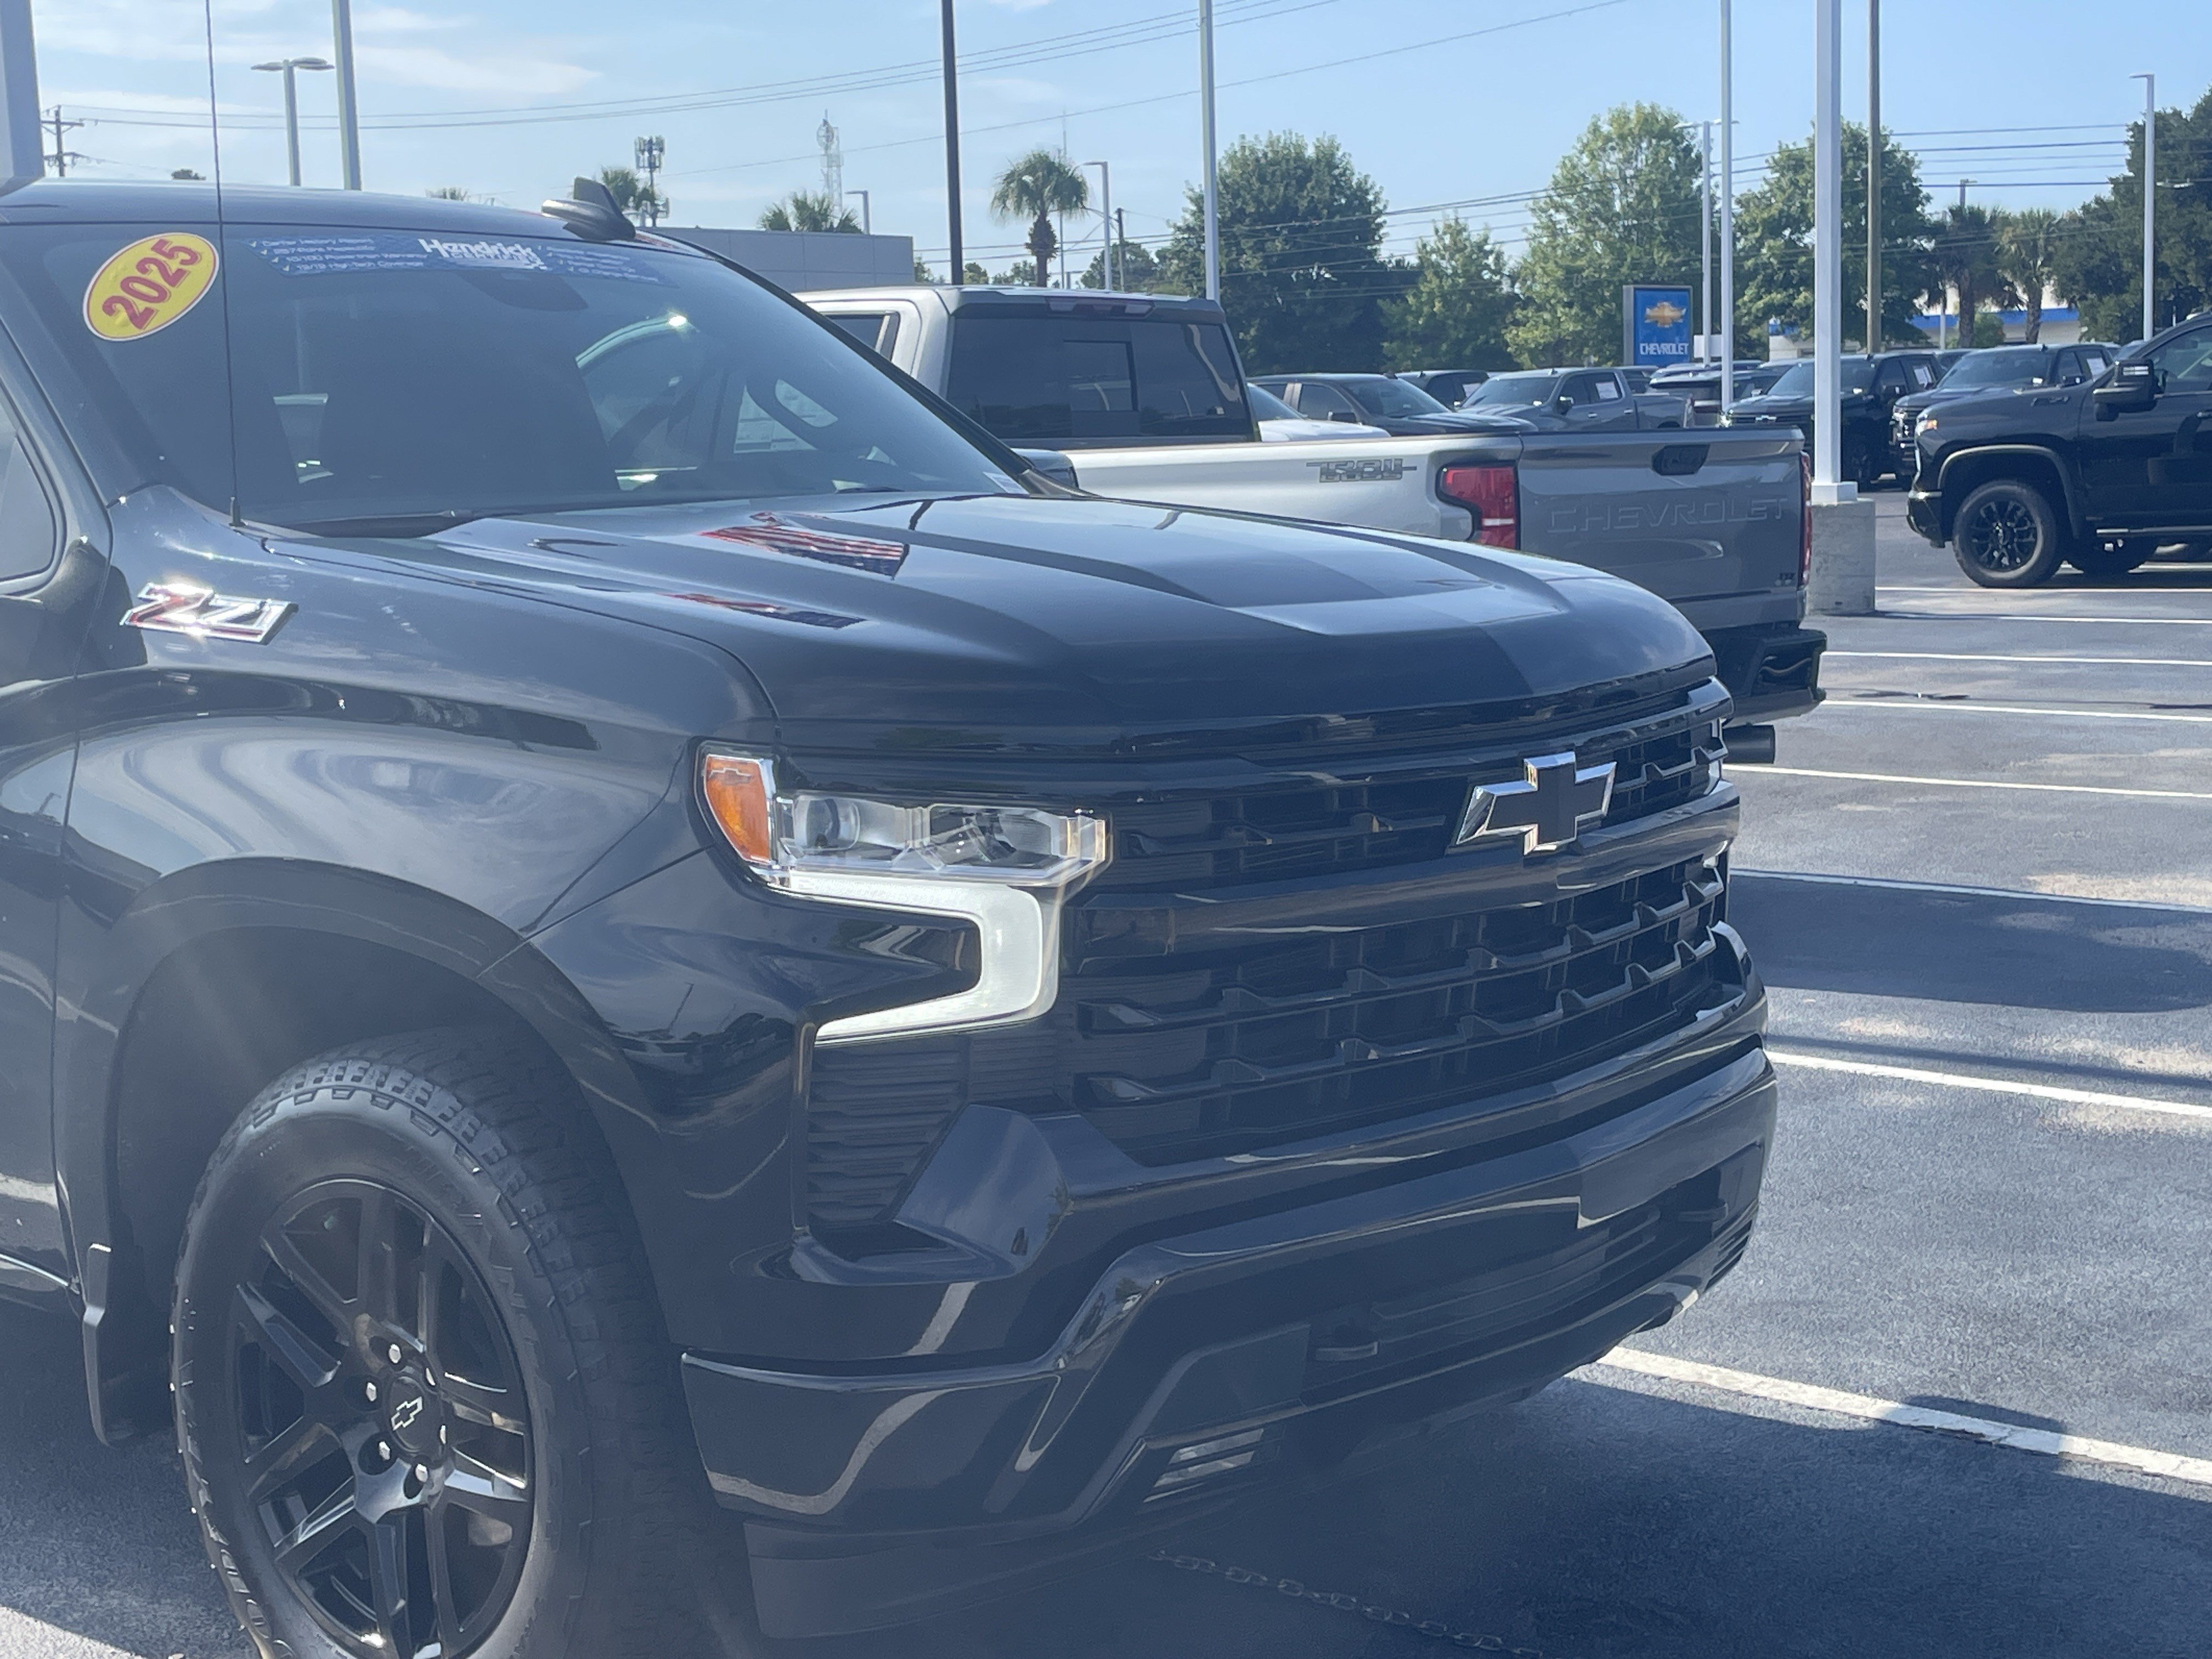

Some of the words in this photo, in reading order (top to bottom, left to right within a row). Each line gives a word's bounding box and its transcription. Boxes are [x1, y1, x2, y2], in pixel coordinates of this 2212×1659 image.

[417, 238, 540, 263] Hendrick
[101, 238, 203, 330] 2025
[1639, 343, 1689, 356] CHEVROLET
[1547, 498, 1788, 533] CHEVROLET
